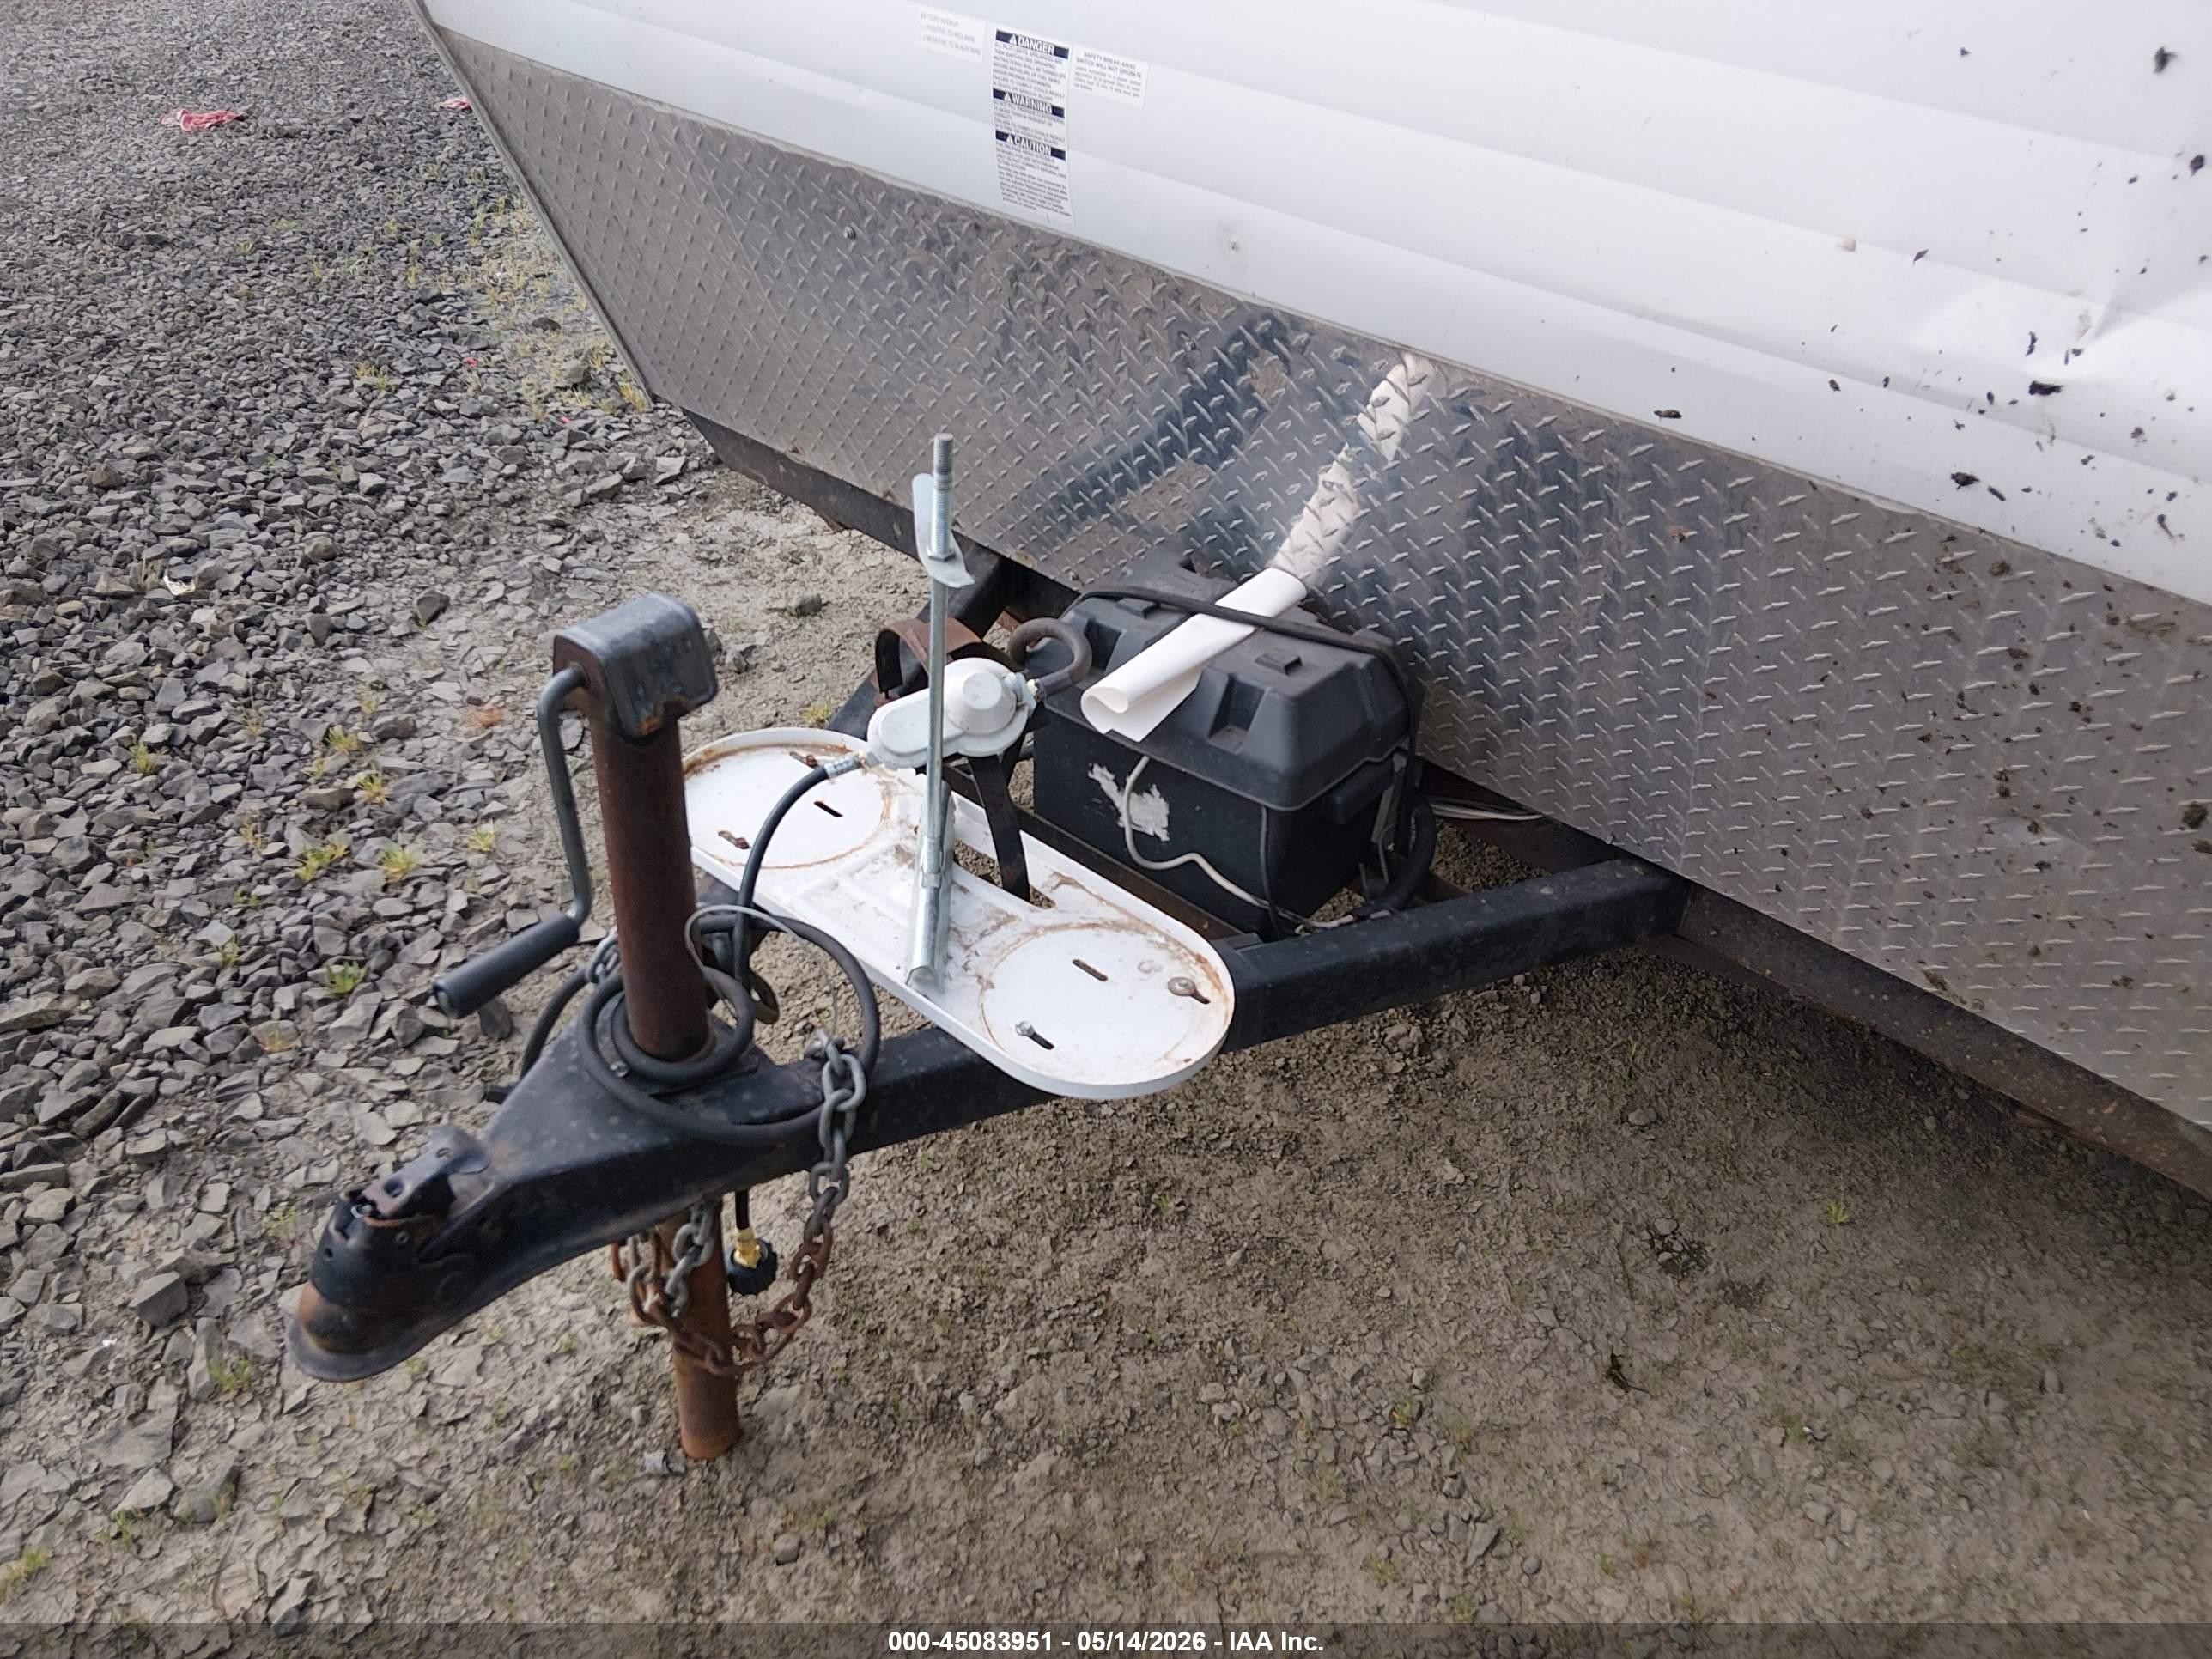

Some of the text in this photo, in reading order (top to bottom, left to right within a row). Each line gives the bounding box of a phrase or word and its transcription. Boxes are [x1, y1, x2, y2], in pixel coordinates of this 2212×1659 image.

[1018, 35, 1055, 55] DANGER
[1012, 92, 1053, 114] WARNING
[1014, 136, 1052, 156] CAUTION
